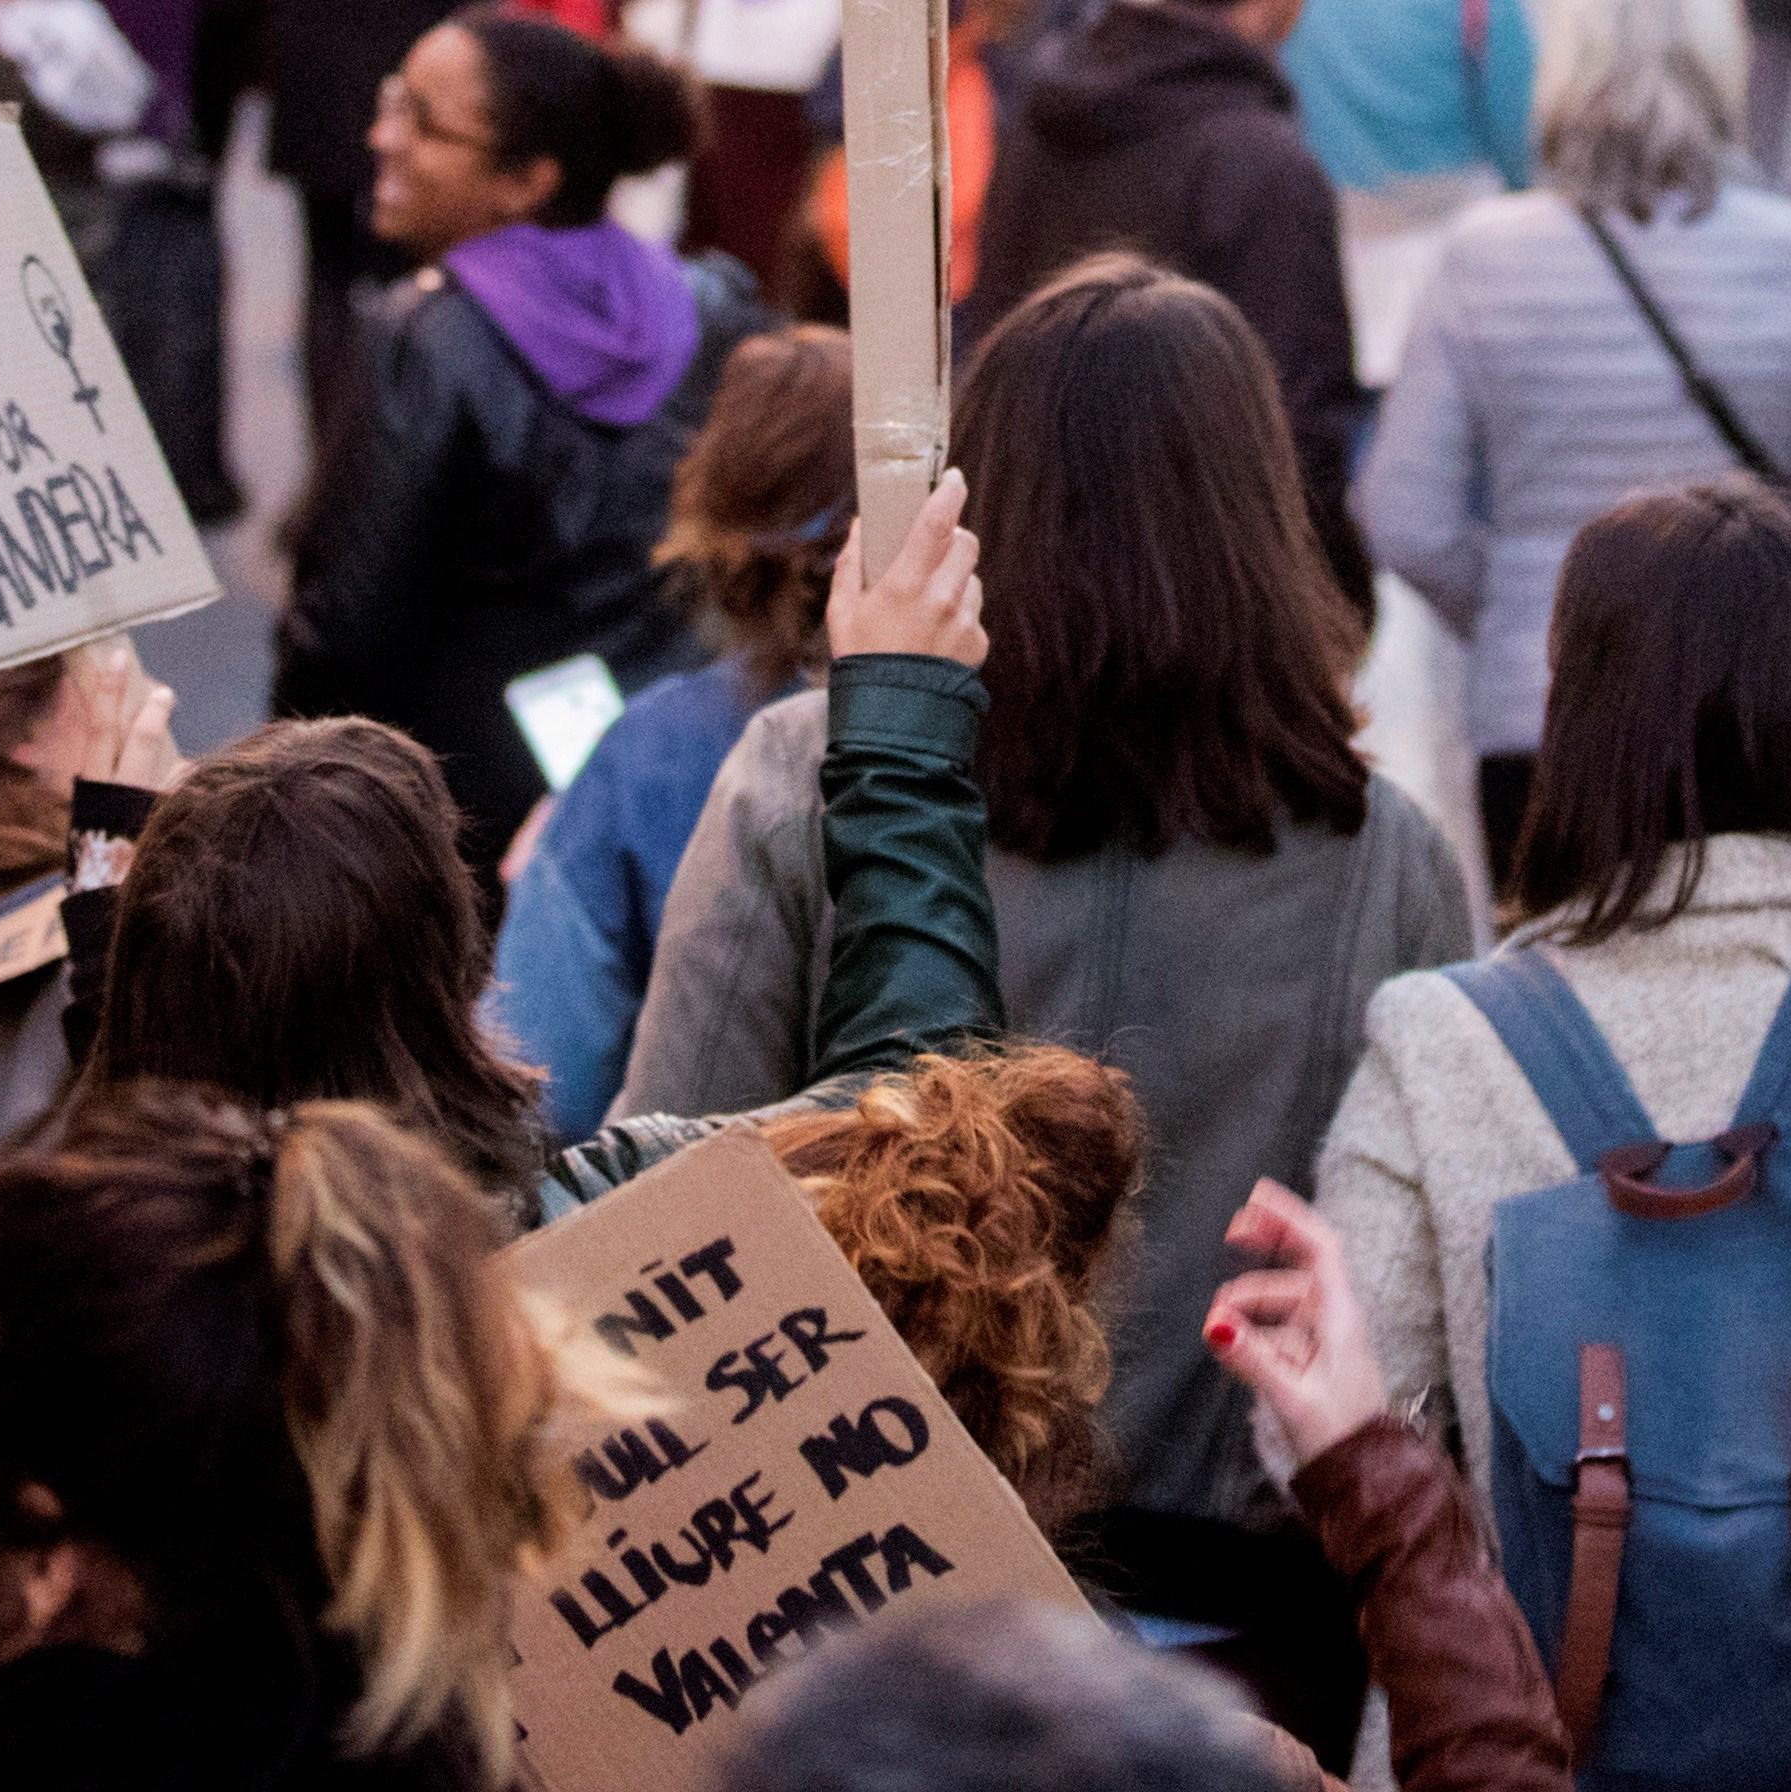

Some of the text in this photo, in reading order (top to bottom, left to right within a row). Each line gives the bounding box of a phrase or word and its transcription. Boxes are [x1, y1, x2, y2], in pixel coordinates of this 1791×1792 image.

[571, 1307, 868, 1502] ULL SER
[798, 1395, 931, 1502] NO
